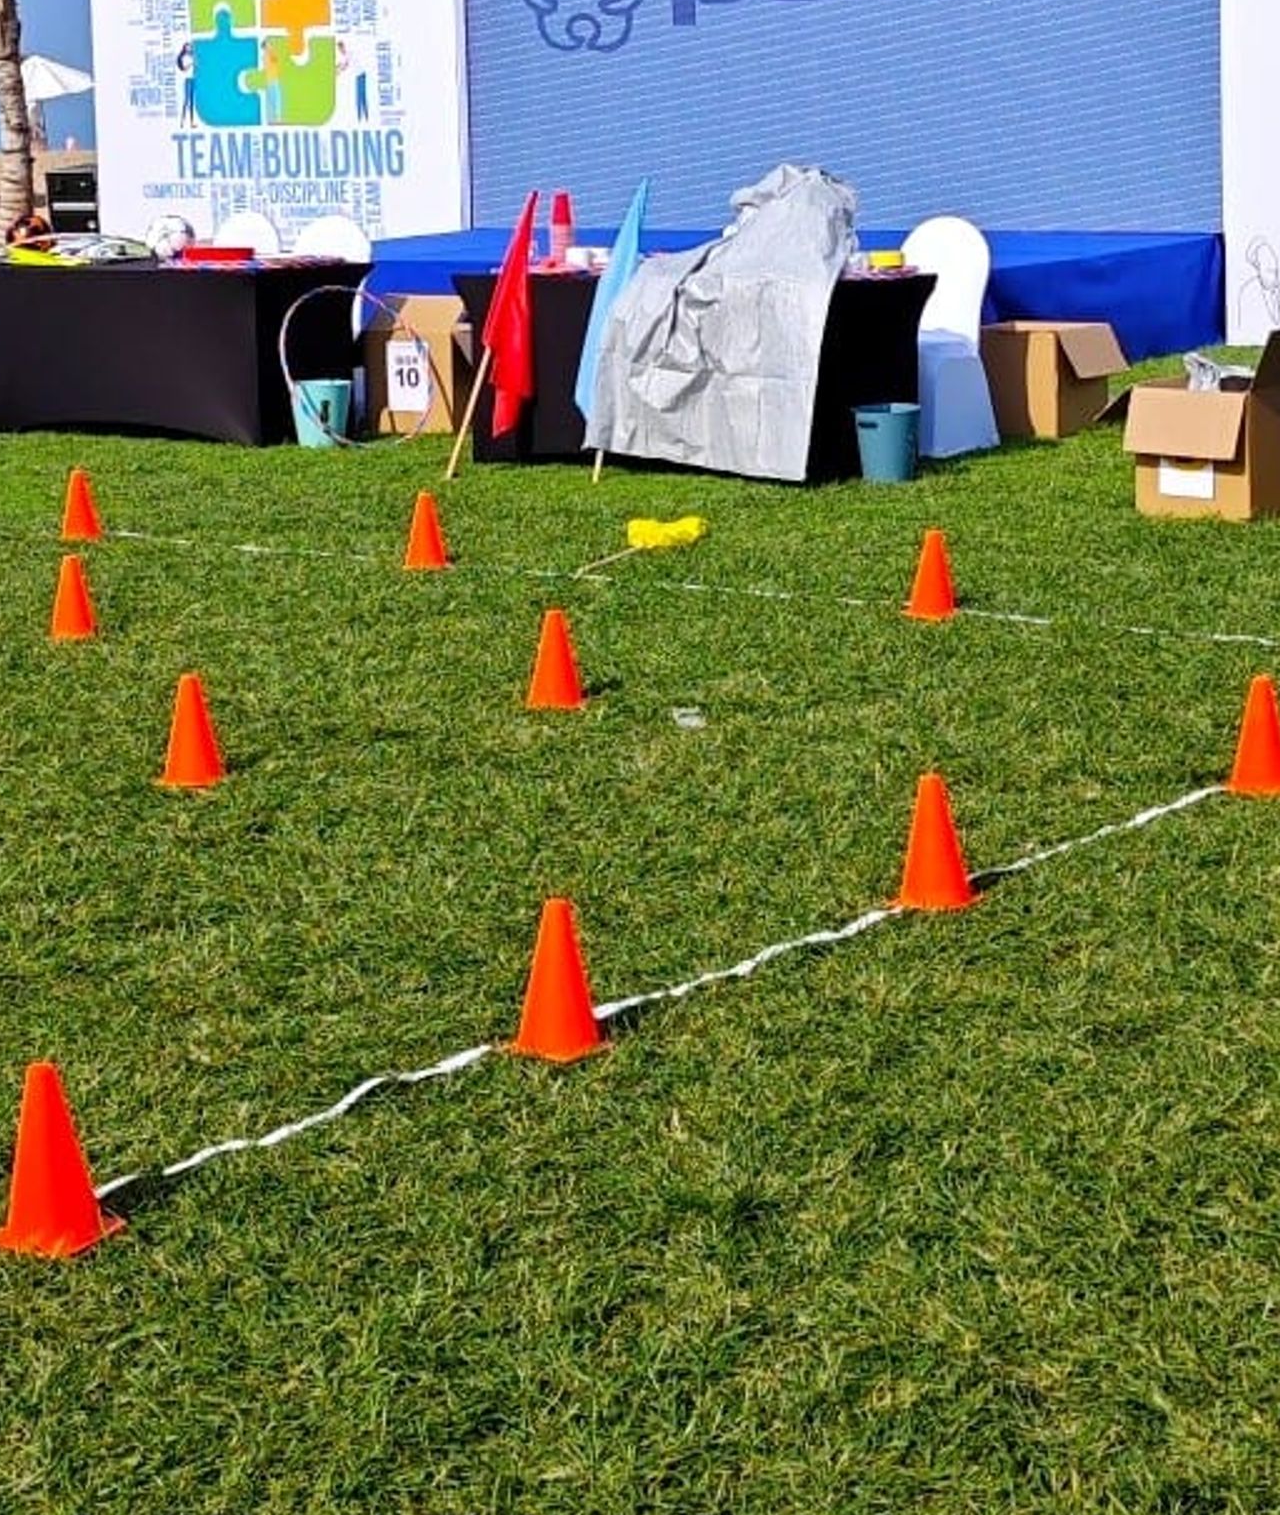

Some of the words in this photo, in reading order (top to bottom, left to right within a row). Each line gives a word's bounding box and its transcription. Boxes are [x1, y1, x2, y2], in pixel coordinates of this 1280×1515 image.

[376, 42, 393, 107] MEMBER
[172, 132, 252, 179] TEAM
[263, 130, 404, 178] BUILDING
[270, 180, 349, 204] DISCIPLINE
[395, 367, 420, 388] 10
